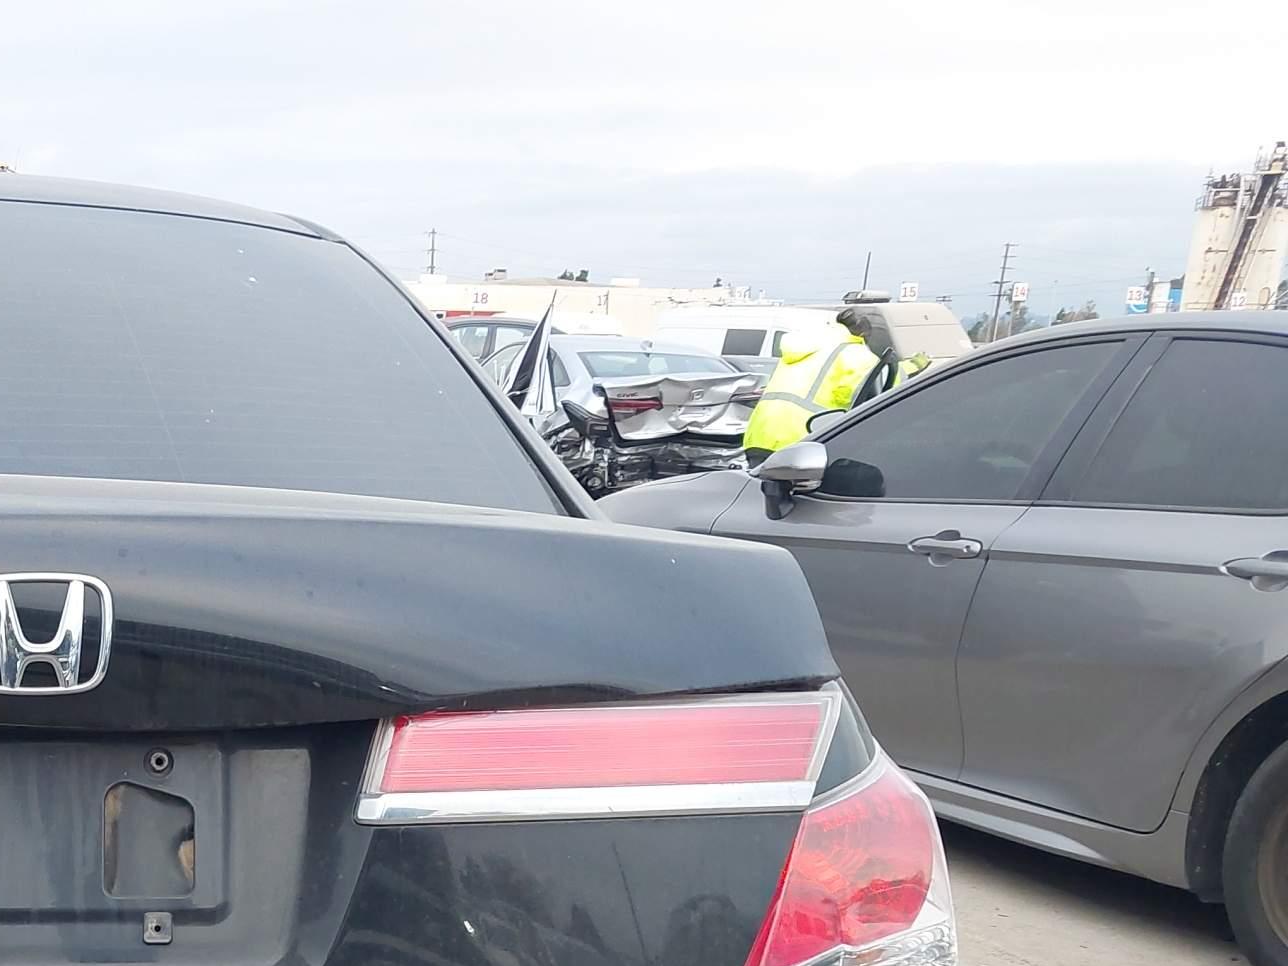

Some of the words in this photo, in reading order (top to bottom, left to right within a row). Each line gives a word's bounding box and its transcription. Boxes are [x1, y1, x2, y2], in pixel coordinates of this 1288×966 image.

[901, 287, 917, 298] 15
[1015, 286, 1026, 297] 14
[1127, 290, 1142, 301] 13
[472, 292, 489, 305] 18
[1231, 296, 1246, 307] 12
